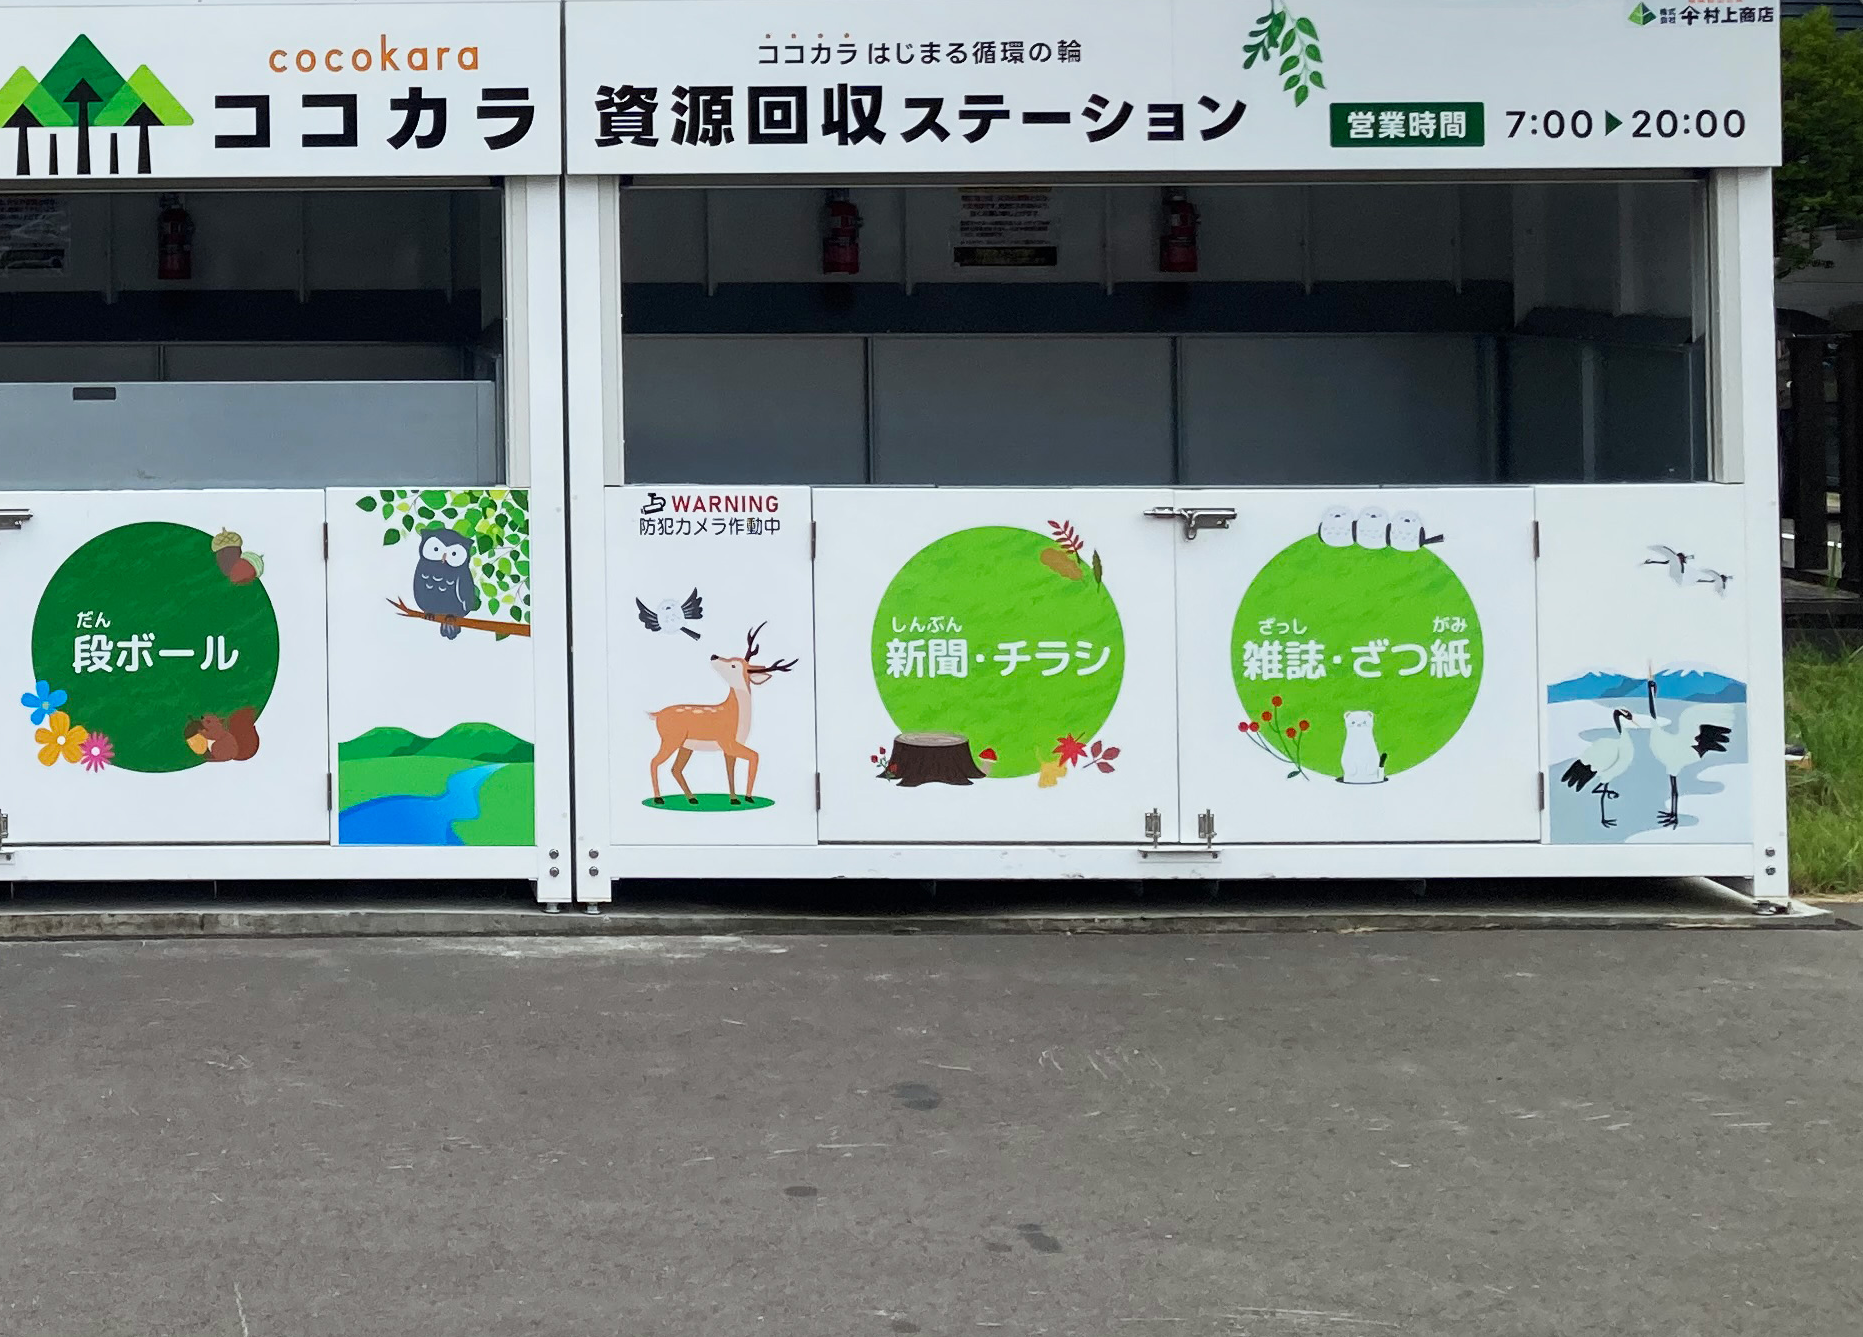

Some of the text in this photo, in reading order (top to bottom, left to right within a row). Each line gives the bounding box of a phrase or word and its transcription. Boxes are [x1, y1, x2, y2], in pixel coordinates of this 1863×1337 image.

[1703, 7, 1774, 23] 村上商店
[269, 34, 478, 72] cocokara
[758, 39, 1082, 64] ココカラはじまる循環の輪
[214, 87, 535, 150] ココカラ
[594, 83, 1247, 147] 資源回収ステーション
[1346, 108, 1746, 139] 営業時間 7:00 20:00
[671, 494, 779, 514] WARNING
[639, 517, 781, 537] 防犯カメラ作動中
[76, 610, 111, 629] だん
[892, 615, 963, 633] しんぶん
[1258, 618, 1308, 636] ざっし
[1432, 615, 1468, 634] がみ
[73, 632, 239, 674] 段ボール
[885, 637, 1111, 679] 新聞・チラシ
[1243, 637, 1472, 681] 雑誌・ざつ紙
